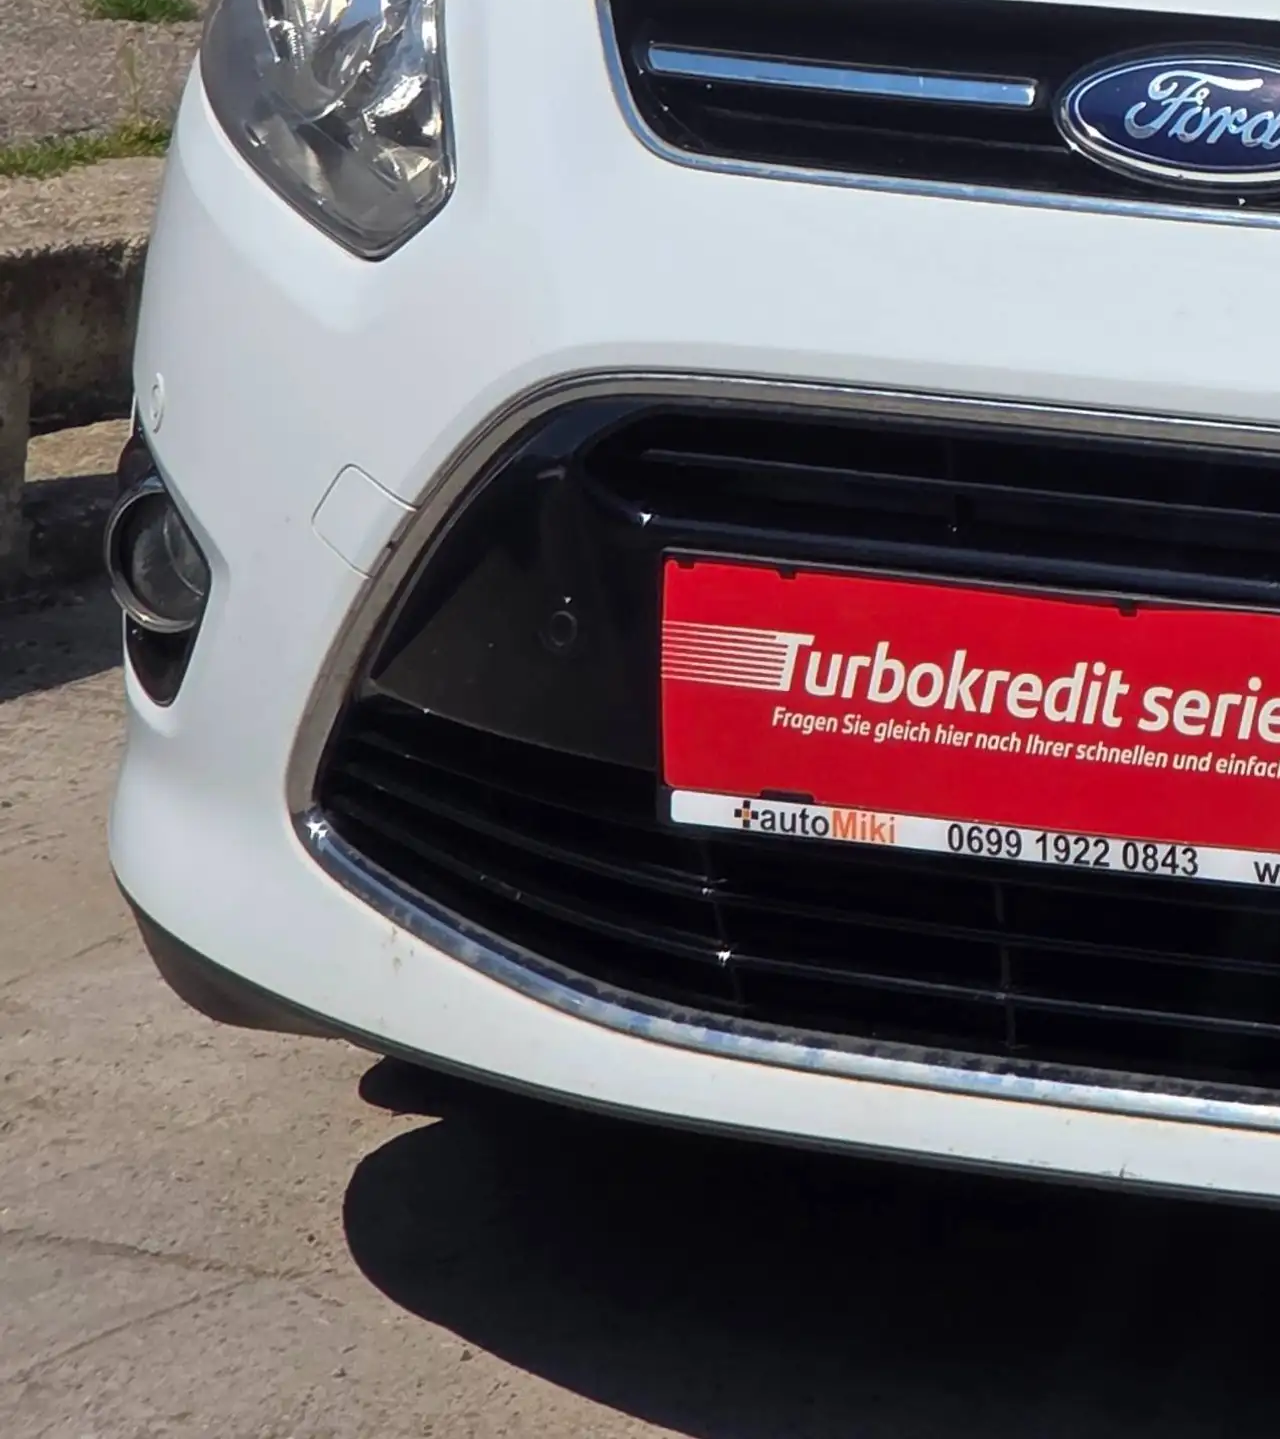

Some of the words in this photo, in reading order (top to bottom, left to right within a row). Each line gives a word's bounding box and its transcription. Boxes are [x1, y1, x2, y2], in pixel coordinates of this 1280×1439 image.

[776, 632, 1130, 728] Turbokredit
[772, 706, 838, 734] Fragen
[842, 713, 871, 736] Sie
[873, 718, 931, 743] gleich
[934, 723, 973, 747] hier
[975, 731, 1022, 754] nach
[1025, 733, 1075, 758] Ihrer
[1075, 741, 1170, 769] schnellen
[1172, 752, 1212, 772] und
[760, 808, 896, 844] autoMiki
[947, 823, 1023, 858] 0699
[1035, 833, 1111, 868] 1922
[1121, 841, 1199, 876] 0843
